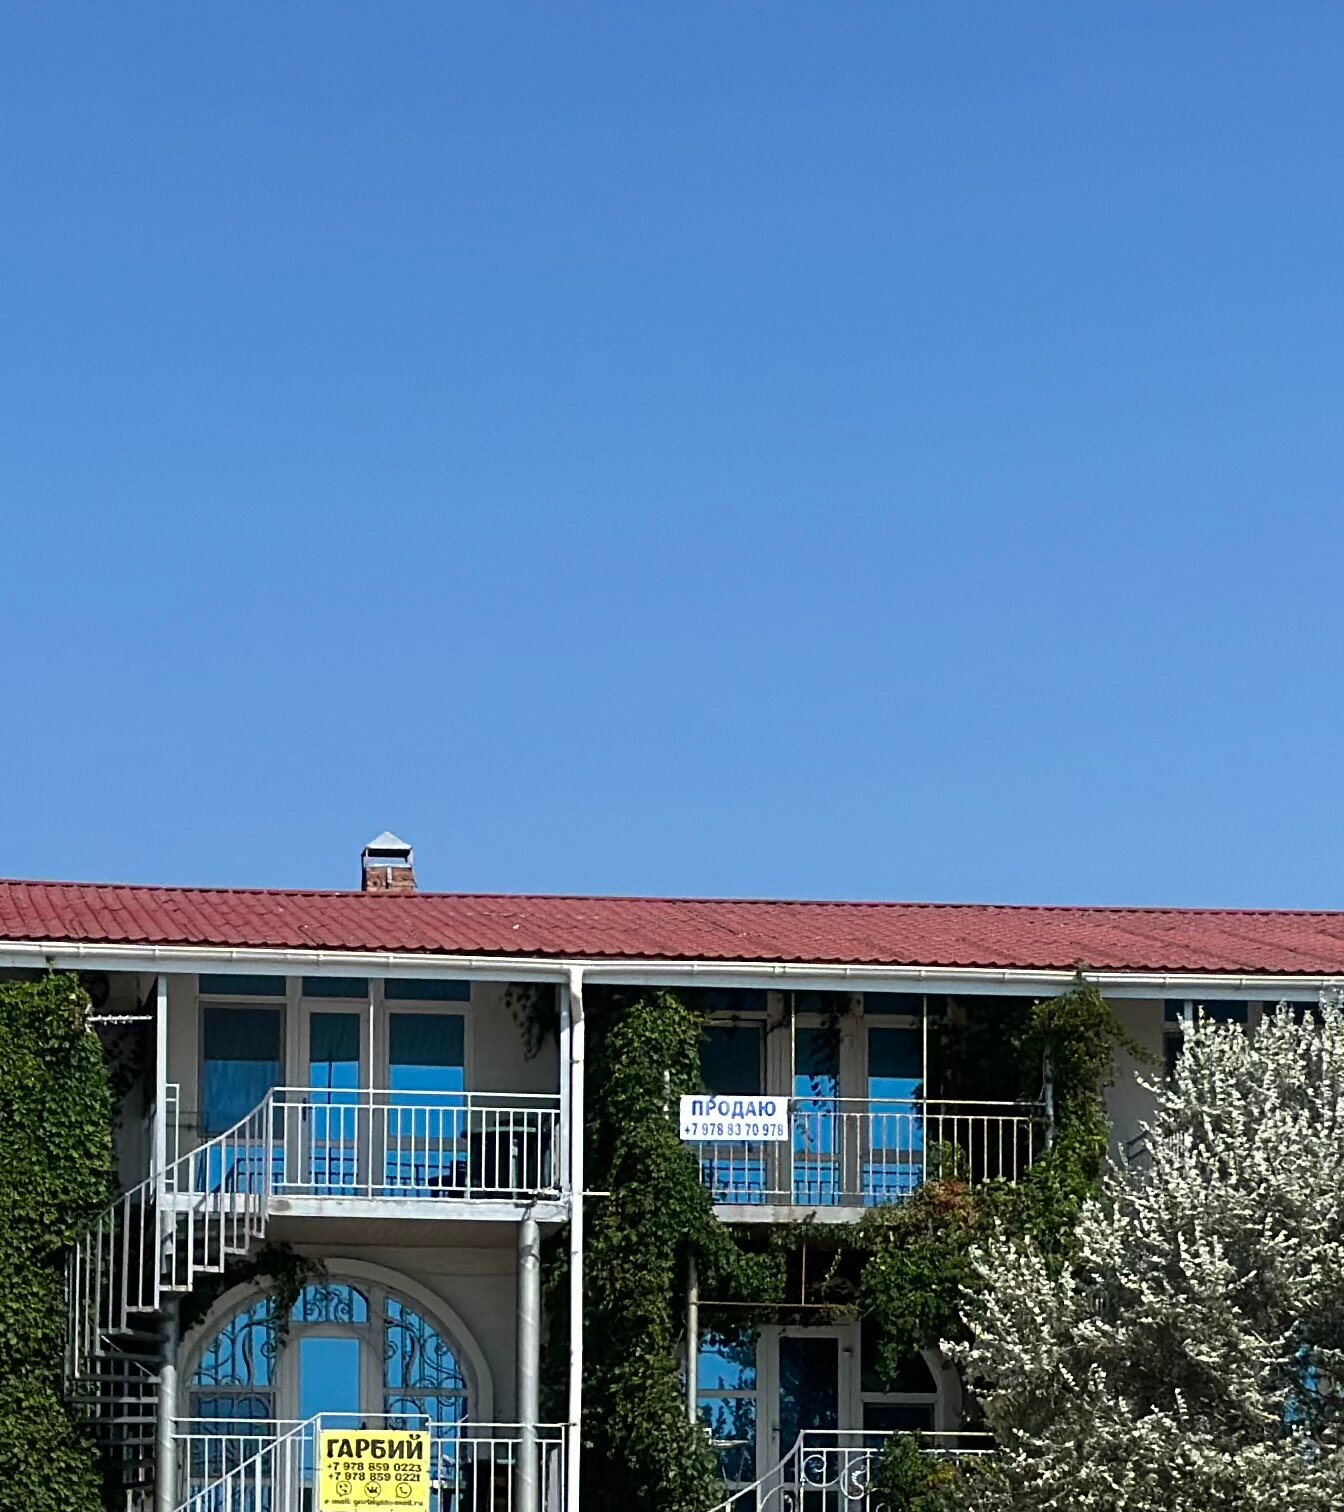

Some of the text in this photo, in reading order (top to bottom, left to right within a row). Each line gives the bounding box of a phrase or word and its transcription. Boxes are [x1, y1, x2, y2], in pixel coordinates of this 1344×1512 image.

[691, 1100, 776, 1119] ПРОДАЮ
[684, 1122, 698, 1136] +7
[701, 1122, 723, 1136] 978
[745, 1123, 759, 1136] 70
[762, 1123, 784, 1136] 978
[326, 1433, 423, 1460] ГАРБИЙ
[327, 1462, 340, 1471] +7
[343, 1462, 364, 1471] 978
[393, 1463, 422, 1473] 0223
[328, 1472, 341, 1481] +7
[344, 1472, 365, 1481] 978
